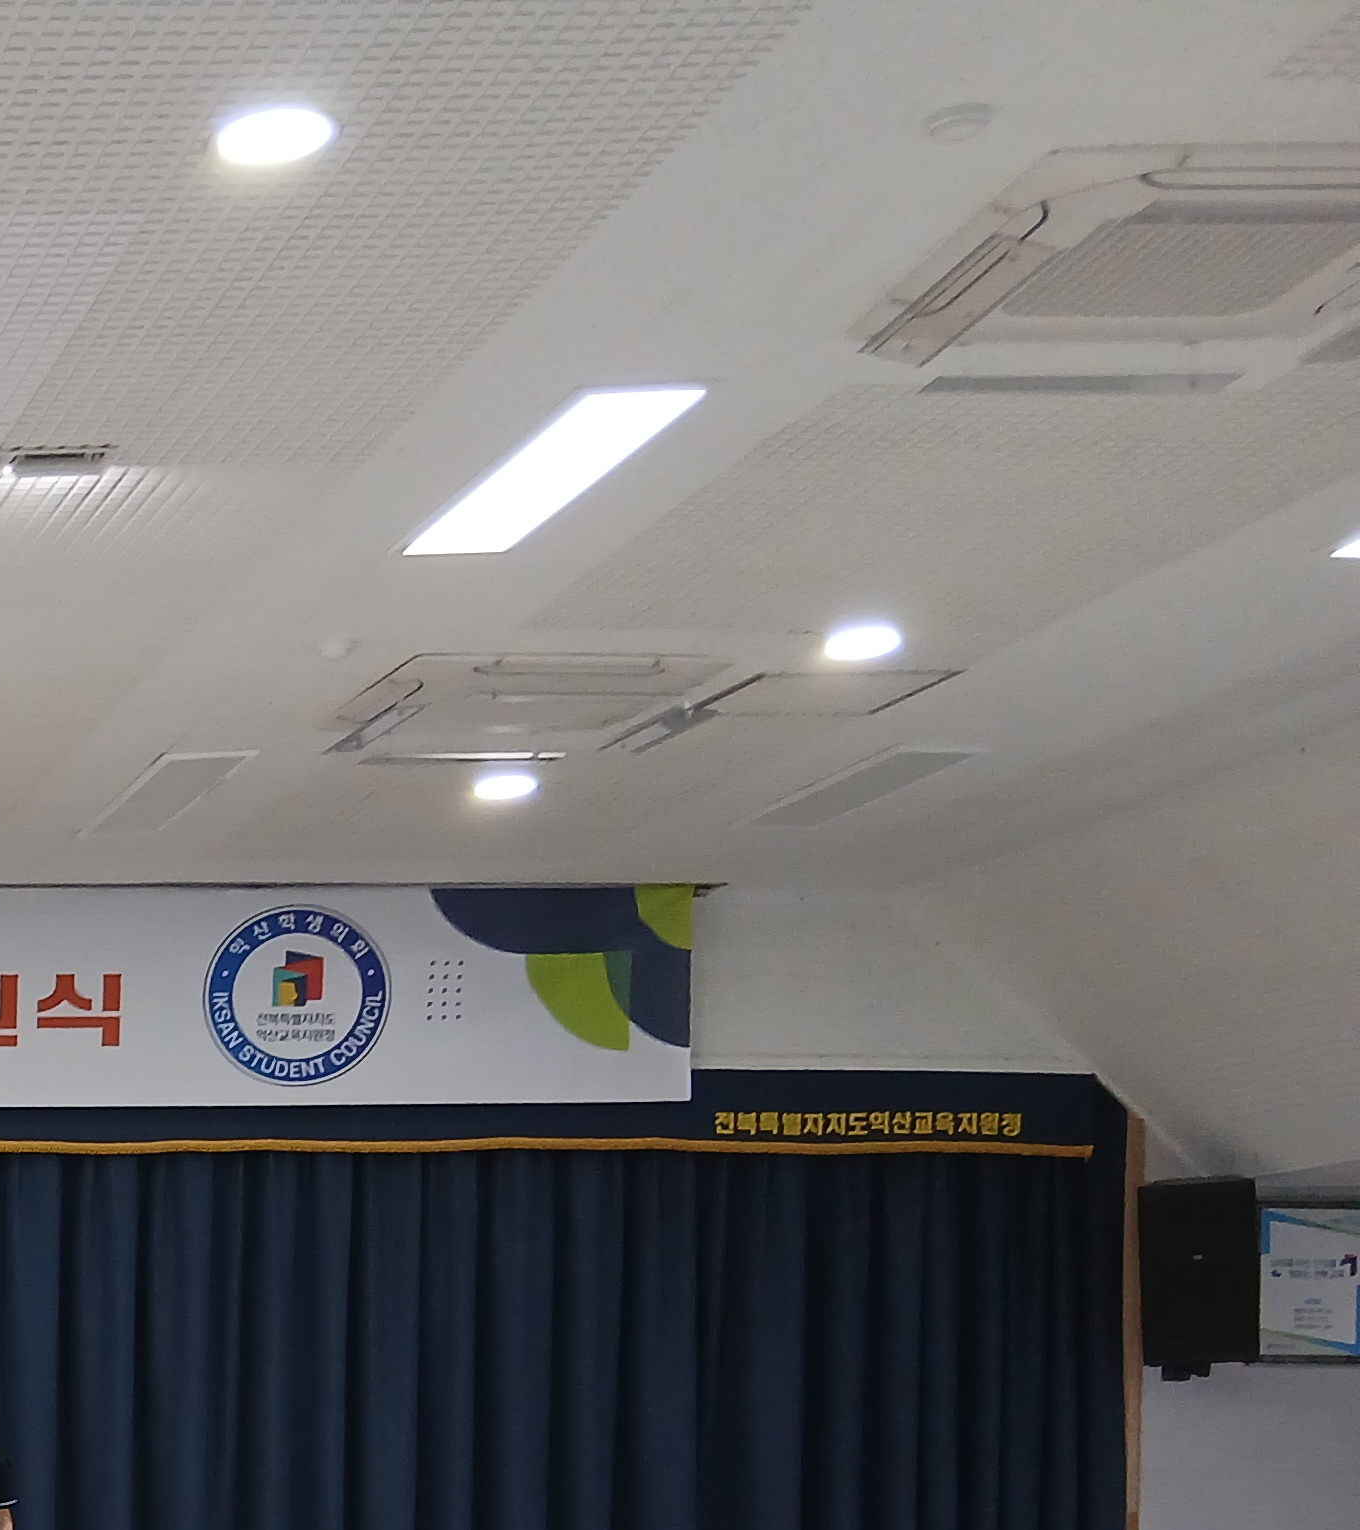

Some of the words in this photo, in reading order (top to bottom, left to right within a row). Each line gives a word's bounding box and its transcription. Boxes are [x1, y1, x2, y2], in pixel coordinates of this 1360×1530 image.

[212, 991, 244, 1050] IKSAN
[238, 1044, 326, 1079] STUDENT
[329, 990, 383, 1067] COUNCIL
[714, 1111, 1022, 1137] 전북특별자치도익산교육지원청
